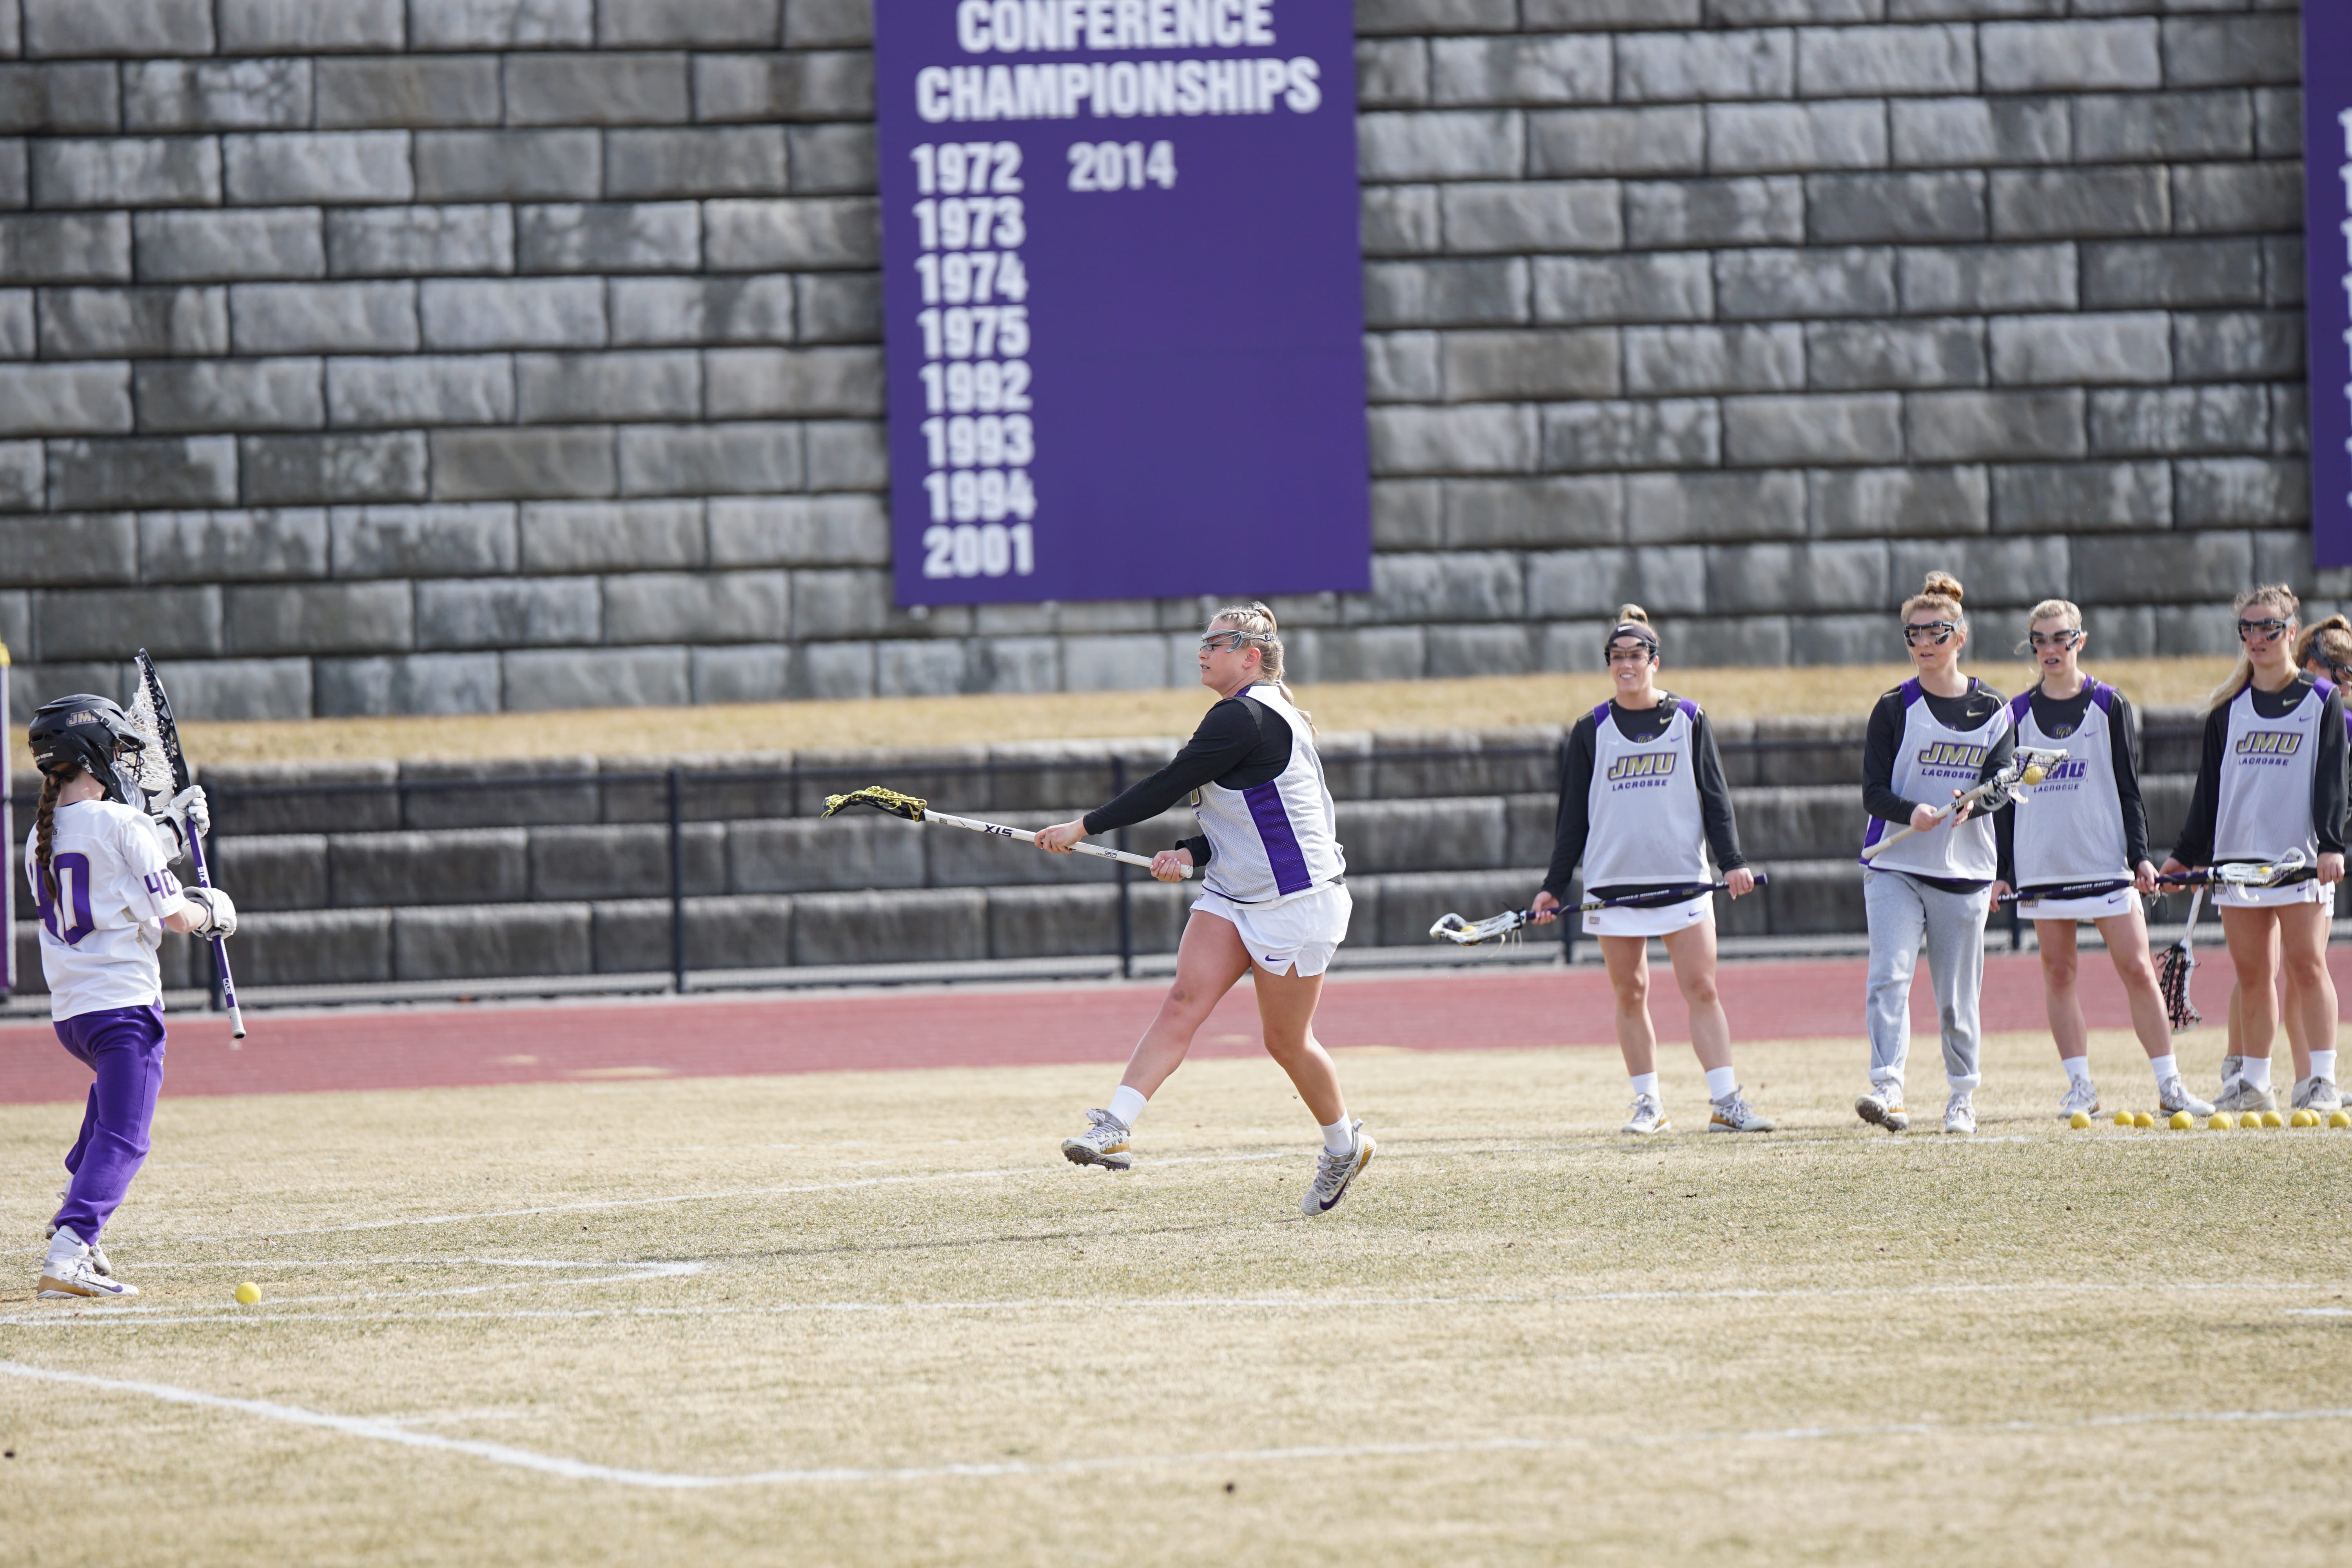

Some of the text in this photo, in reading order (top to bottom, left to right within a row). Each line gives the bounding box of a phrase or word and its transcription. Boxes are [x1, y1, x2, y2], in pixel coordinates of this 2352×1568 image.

[957, 0, 1275, 53] CONFERENCE
[916, 57, 1321, 122] CHAMPIONSHIPS
[911, 140, 1176, 194] 1972 2014
[913, 196, 1025, 250] 1973
[915, 251, 1028, 304] 1974
[917, 305, 1030, 359] 1975
[920, 359, 1032, 413] 1992
[922, 414, 1034, 468] 1993
[924, 469, 1036, 522] 1994
[924, 523, 1034, 577] 2001
[1917, 740, 1987, 769] JMU
[2235, 731, 2303, 755] JMU
[2239, 757, 2289, 766] LACROSSE
[1608, 752, 1677, 781] JMU
[1612, 779, 1667, 791] LACROSSE
[1922, 768, 1978, 780] LACROSSE
[984, 824, 1014, 837] STX
[144, 869, 177, 899] 40
[197, 866, 208, 882] STX
[1580, 900, 1606, 911] STX
